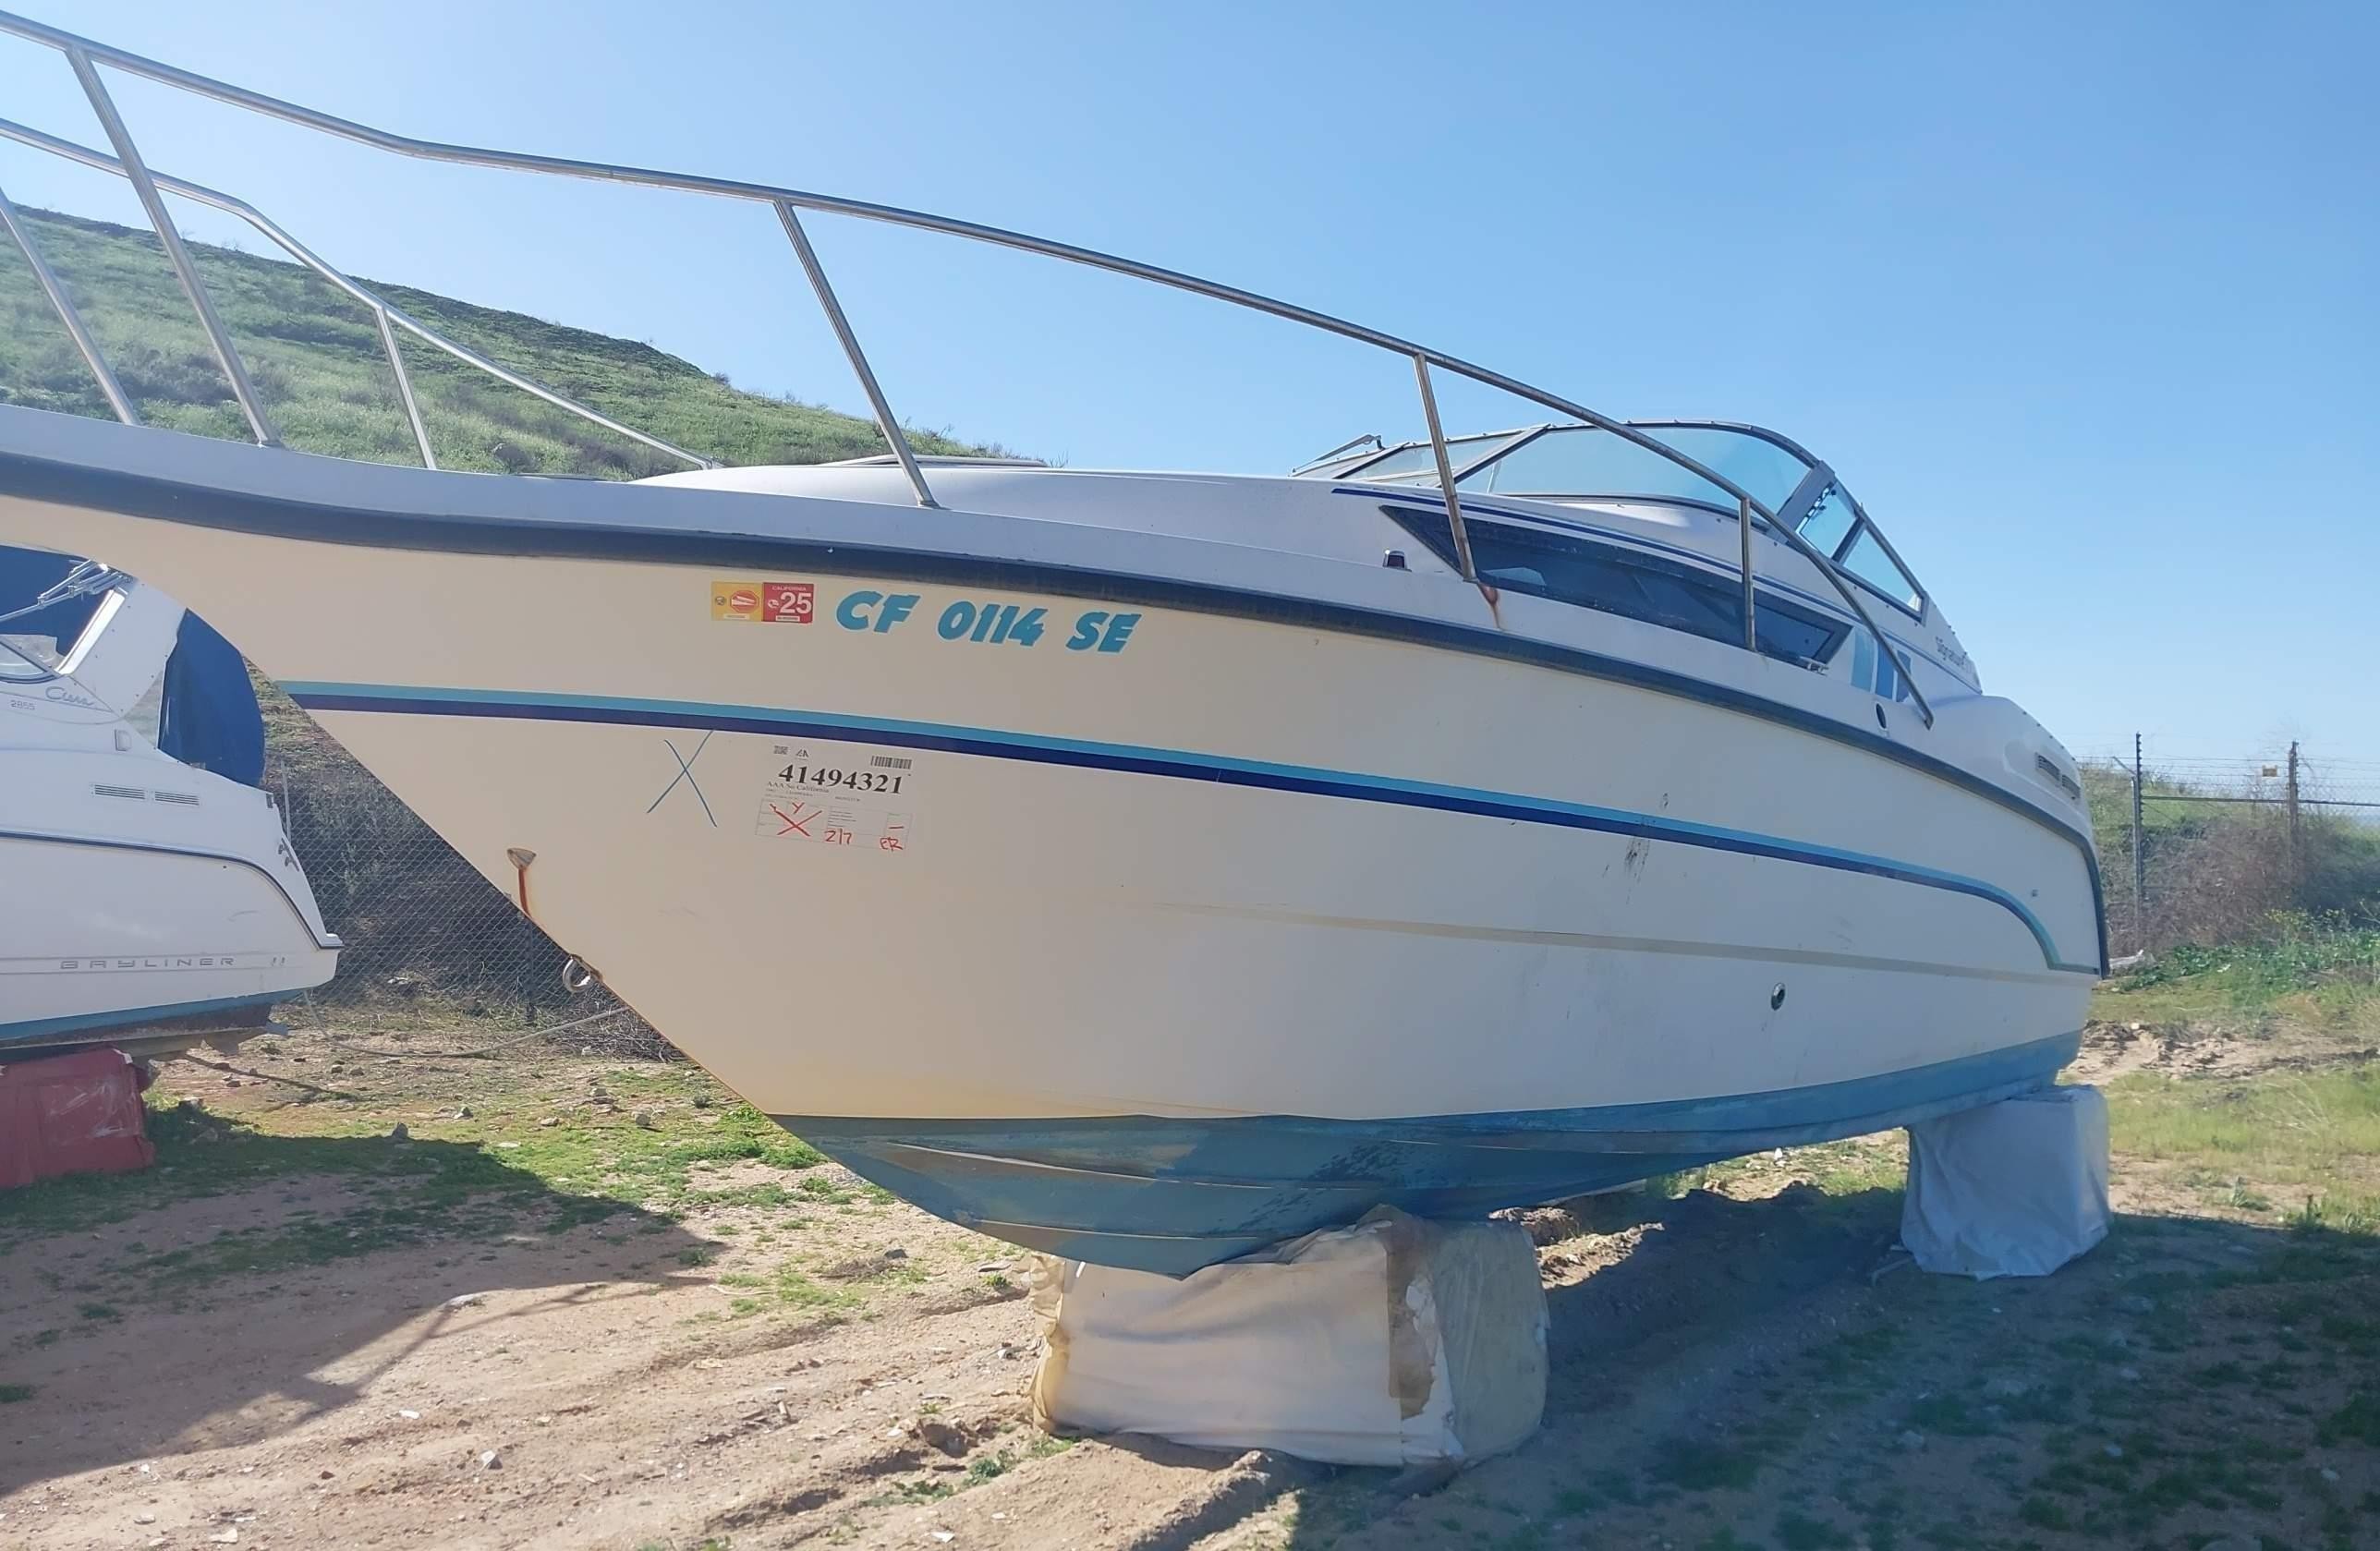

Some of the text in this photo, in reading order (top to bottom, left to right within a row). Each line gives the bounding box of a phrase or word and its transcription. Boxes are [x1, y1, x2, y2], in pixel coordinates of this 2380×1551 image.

[780, 591, 812, 613] 25
[835, 590, 1142, 653] CF 0114 SE
[778, 764, 902, 794] 41494321
[60, 957, 235, 970] BAYLINER
